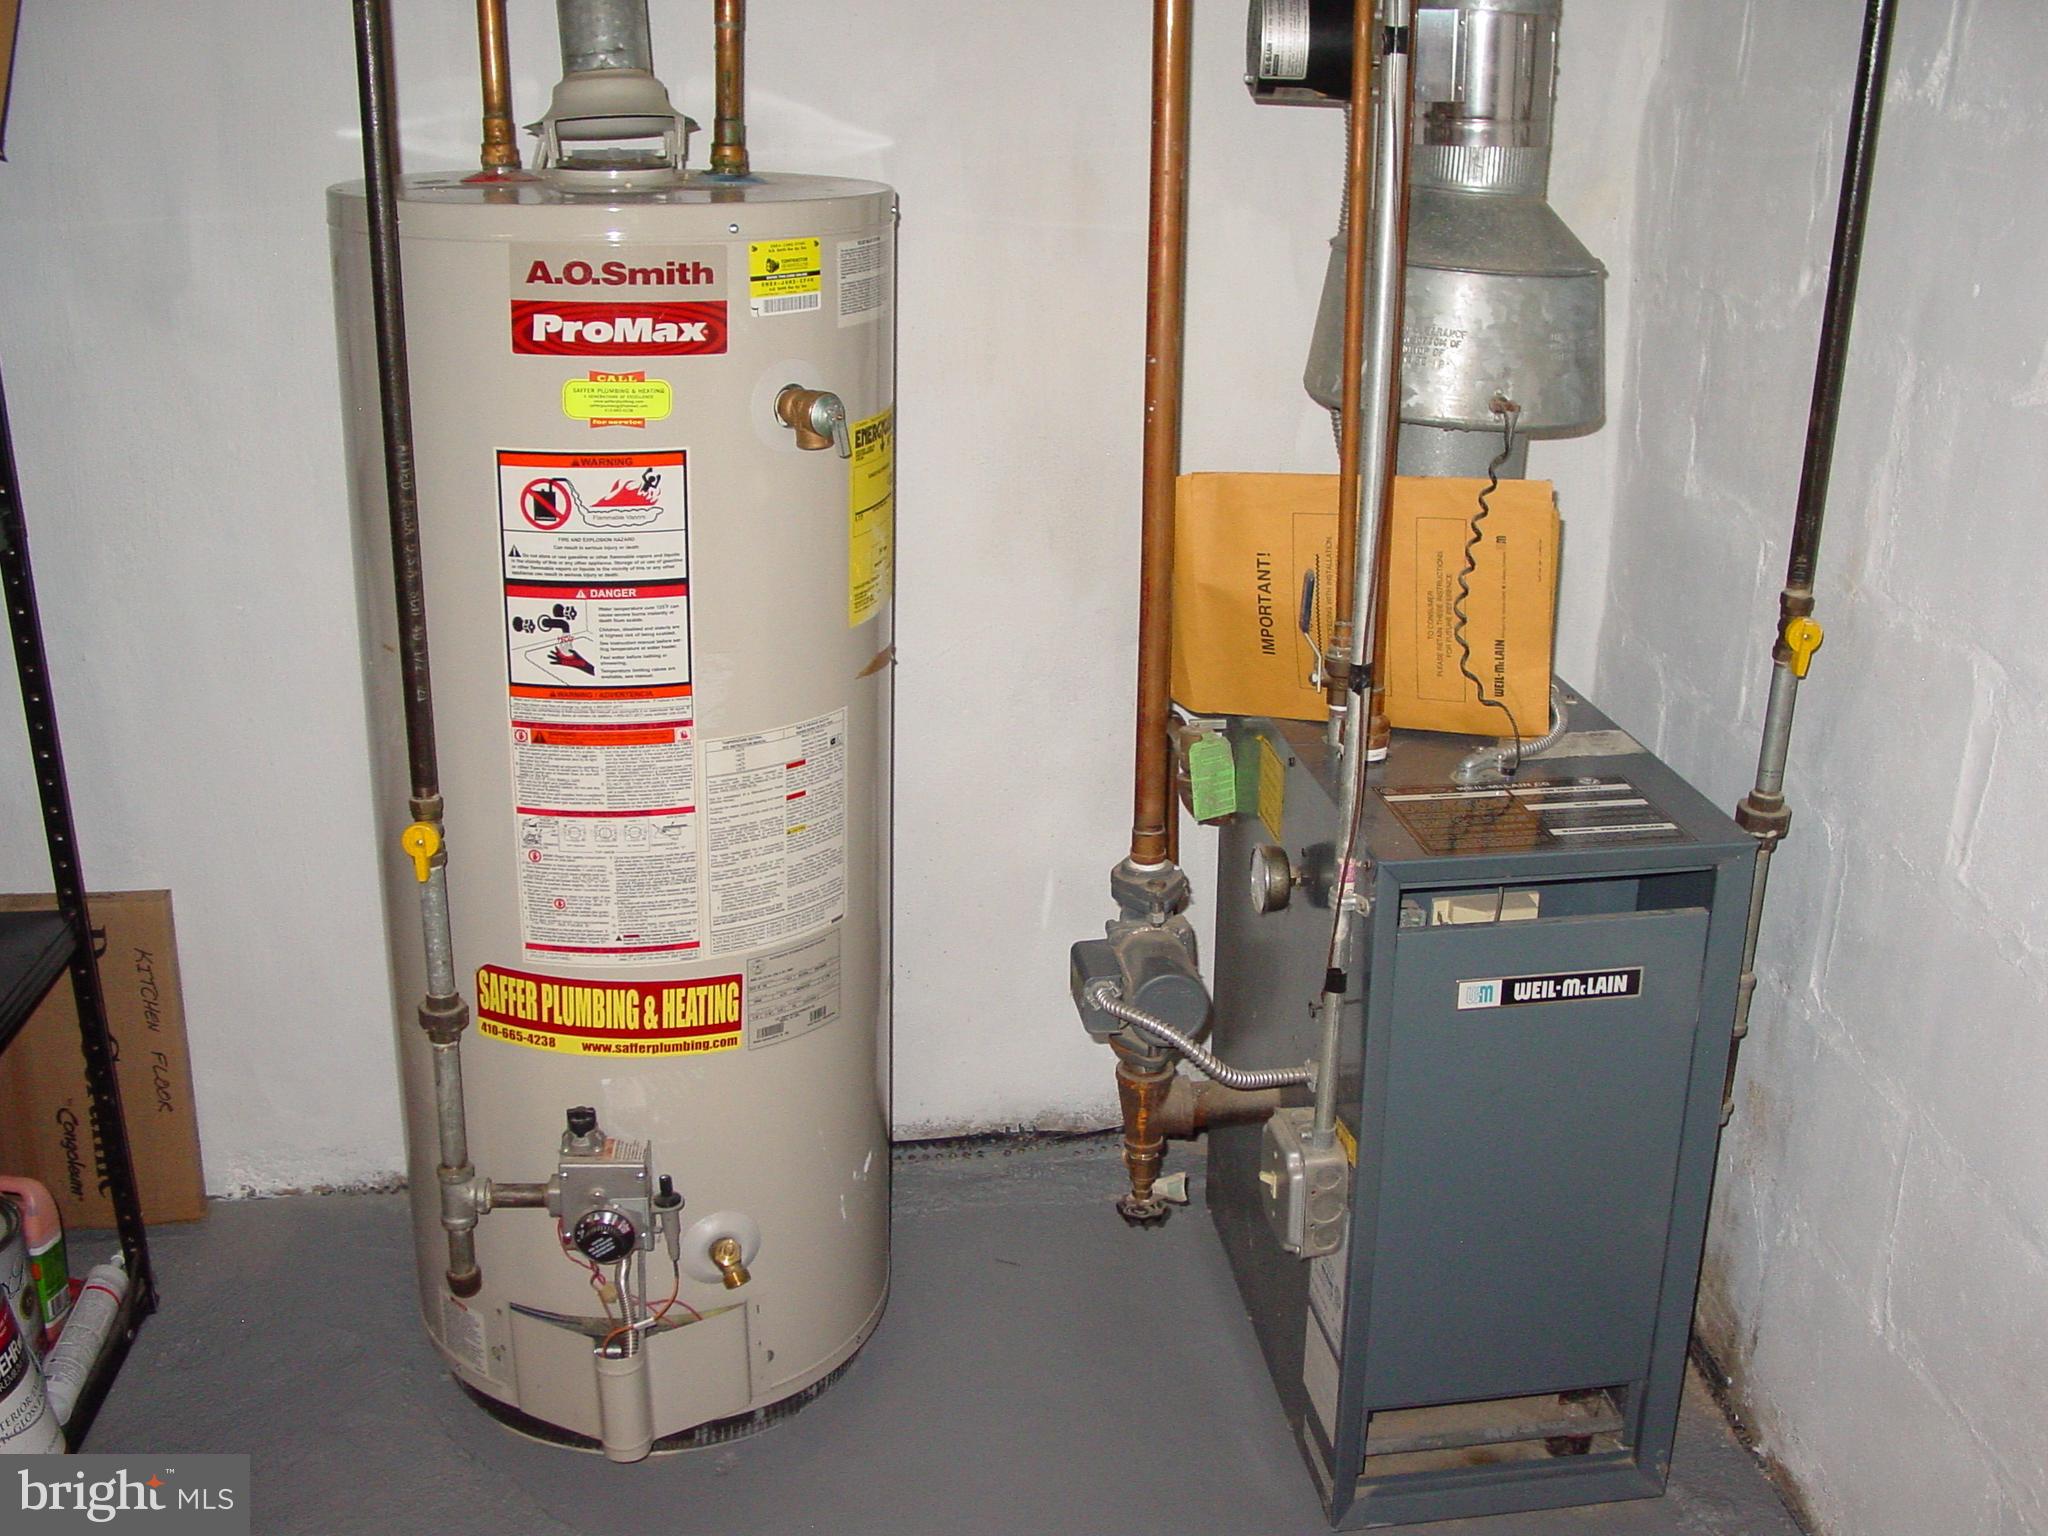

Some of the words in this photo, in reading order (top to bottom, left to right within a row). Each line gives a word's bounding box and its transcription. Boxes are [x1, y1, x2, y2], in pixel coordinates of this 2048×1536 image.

[525, 260, 714, 285] A.O.Smith
[532, 314, 703, 343] ProMax
[596, 374, 637, 382] CALL
[580, 458, 633, 466] WARNING
[590, 588, 637, 598] DANGER
[1256, 552, 1276, 656] IMPORTANT!
[1427, 631, 1433, 640] TO
[477, 968, 538, 1022] SAFFER
[541, 982, 640, 1031] PLUMBING
[644, 995, 659, 1030] &
[662, 982, 740, 1029] HEATING
[134, 947, 161, 1033] KITCHEN
[150, 1051, 174, 1113] FLOOR
[480, 1021, 556, 1048] 410-665-4238
[582, 1036, 738, 1054] www.safferplumbing.com
[0, 1333, 22, 1378] EHR
